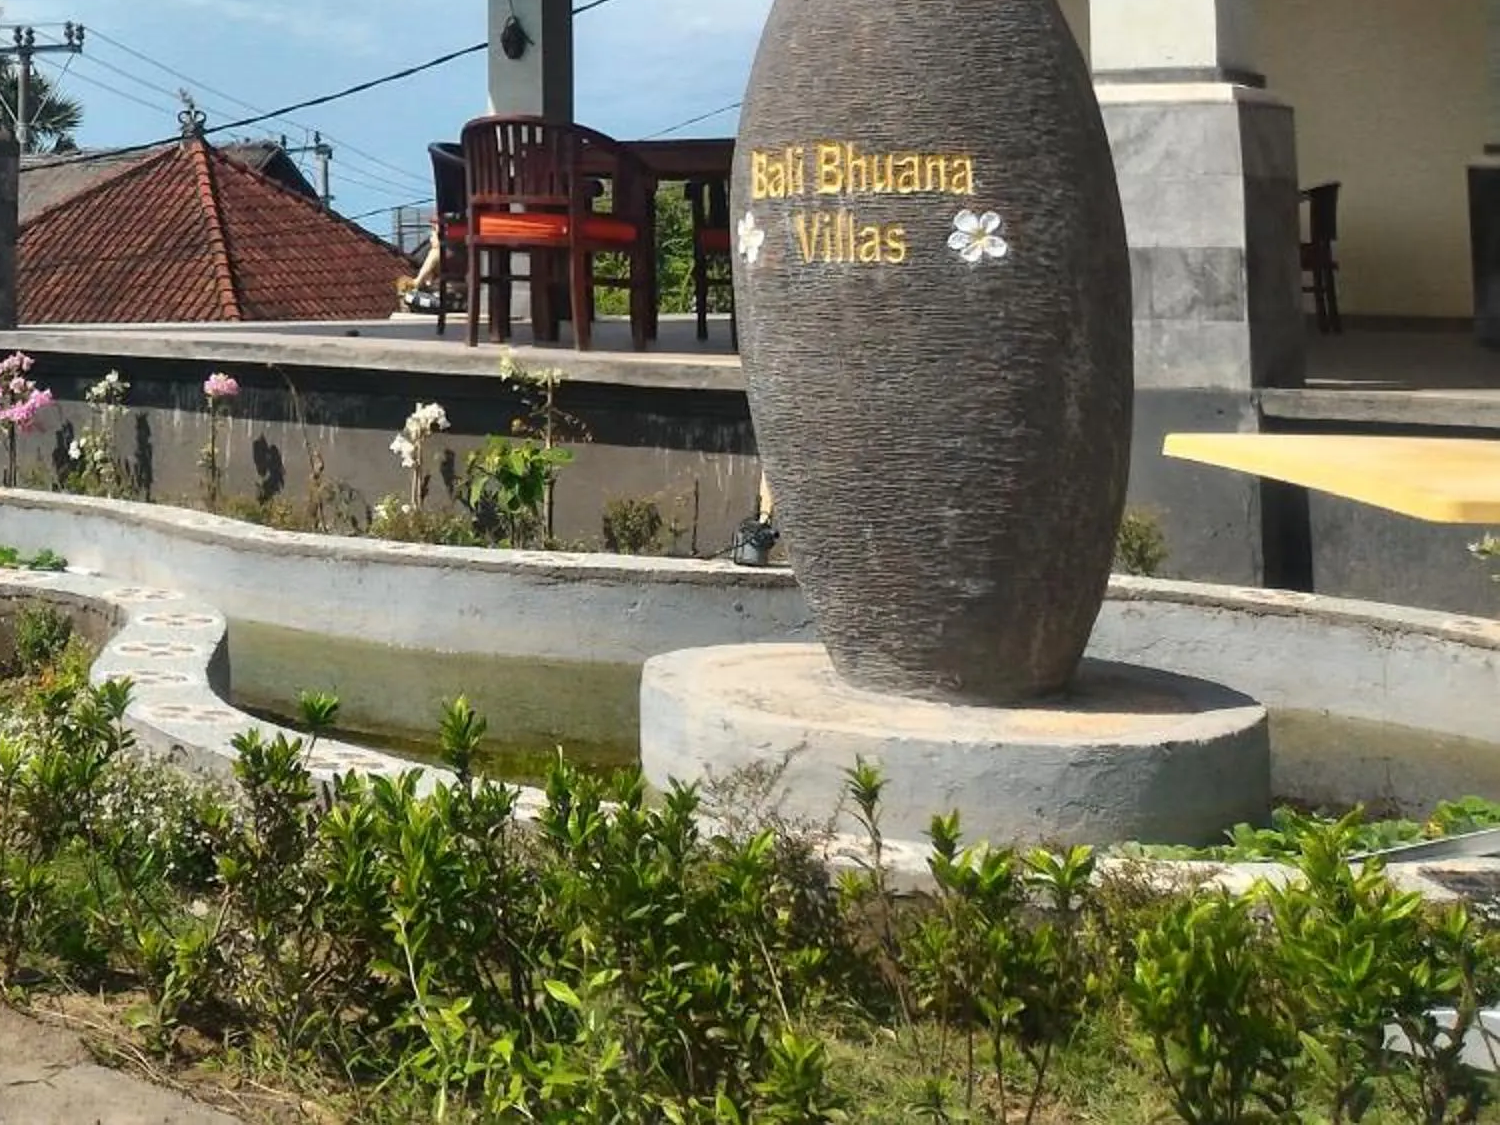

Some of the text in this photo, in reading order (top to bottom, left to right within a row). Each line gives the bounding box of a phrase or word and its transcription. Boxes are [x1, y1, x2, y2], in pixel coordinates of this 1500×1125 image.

[751, 140, 975, 199] Bali Bhuana
[795, 207, 907, 264] Villas
